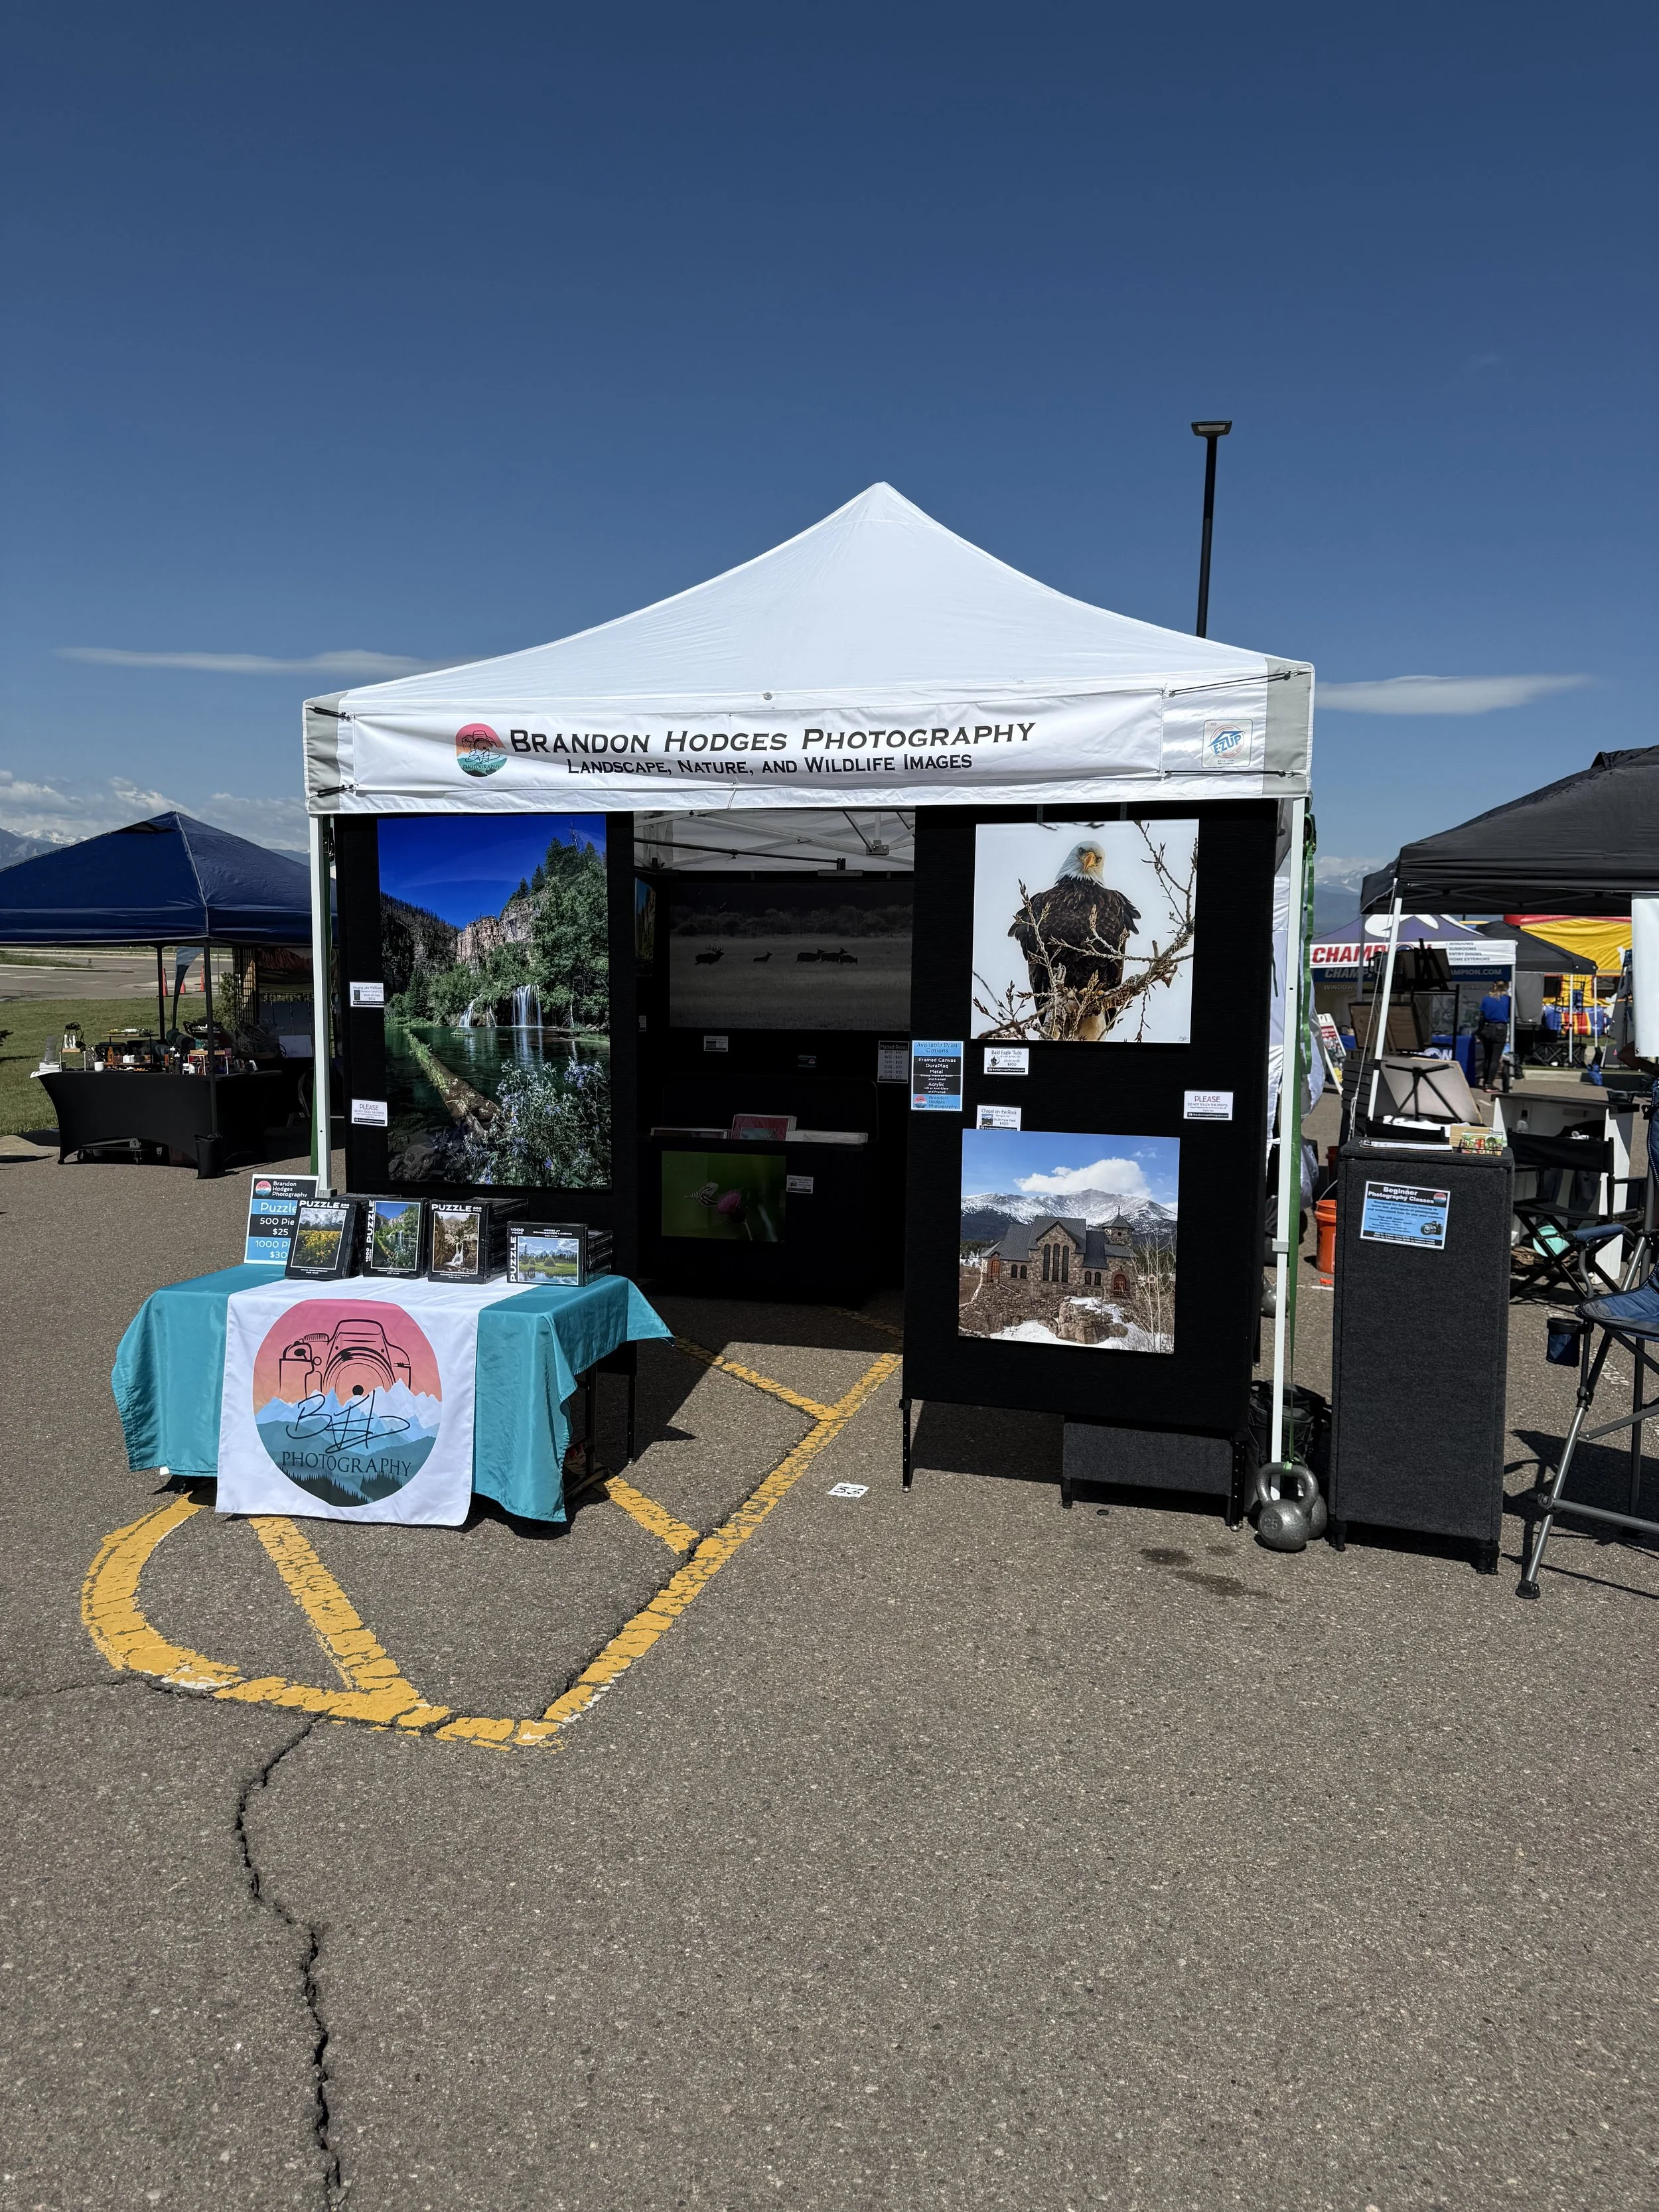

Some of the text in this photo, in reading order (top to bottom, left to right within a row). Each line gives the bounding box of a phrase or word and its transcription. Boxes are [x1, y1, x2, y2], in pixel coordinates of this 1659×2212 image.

[510, 722, 1037, 753] BRANDON HODGES PHOTOGRAPHY
[761, 760, 797, 773] AND
[804, 756, 895, 773] WILDLIFE
[903, 753, 973, 770] IMAGES
[1368, 1191, 1407, 1200] Photography
[1383, 1187, 1418, 1195] Beginner
[299, 1200, 340, 1209] PUZZLE
[431, 1203, 472, 1212] PUZZLE
[366, 1200, 375, 1244] PUZZLE
[255, 1240, 279, 1248] 1000
[281, 1451, 413, 1477] PHOTOGRAPHY
